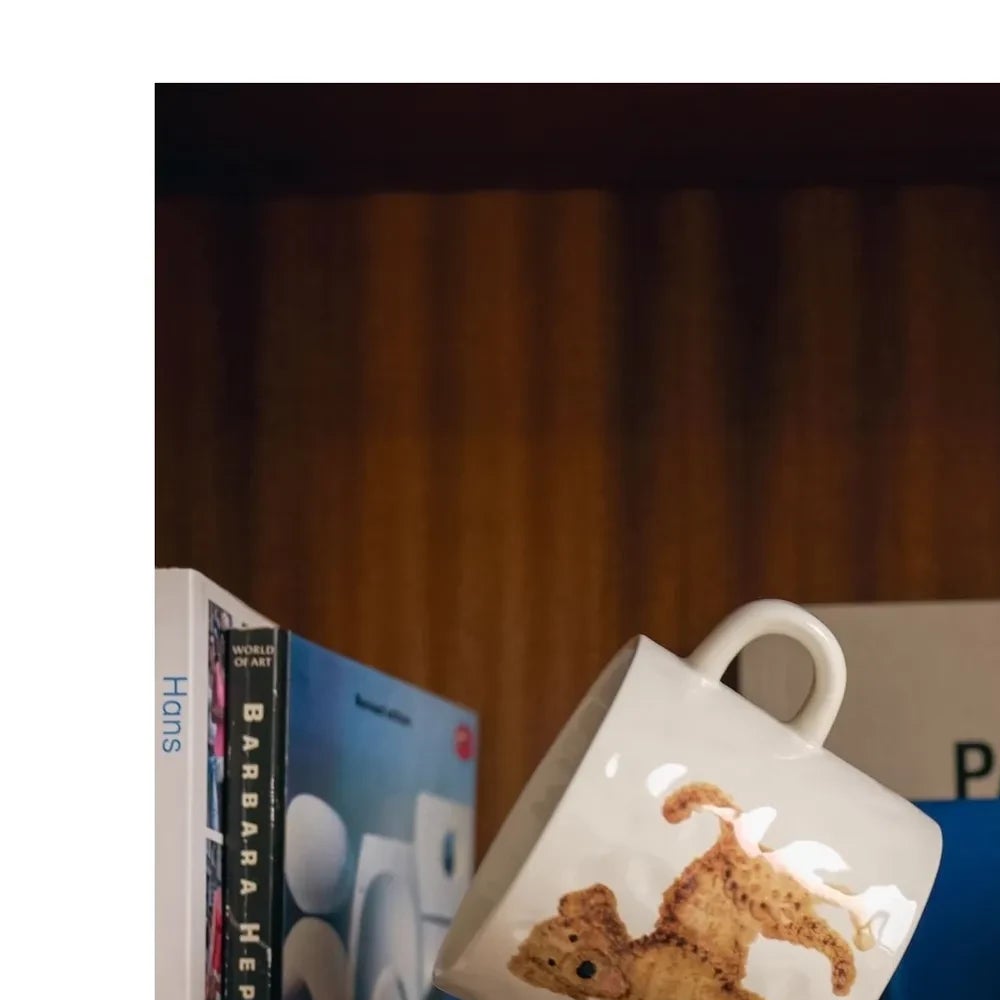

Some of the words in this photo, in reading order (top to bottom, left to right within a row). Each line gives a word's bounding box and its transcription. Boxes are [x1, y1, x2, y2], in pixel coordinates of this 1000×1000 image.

[232, 645, 275, 656] WORLD
[234, 657, 249, 668] OF
[251, 657, 272, 668] ART
[162, 676, 188, 754] Hans
[240, 703, 264, 894] BARBARA
